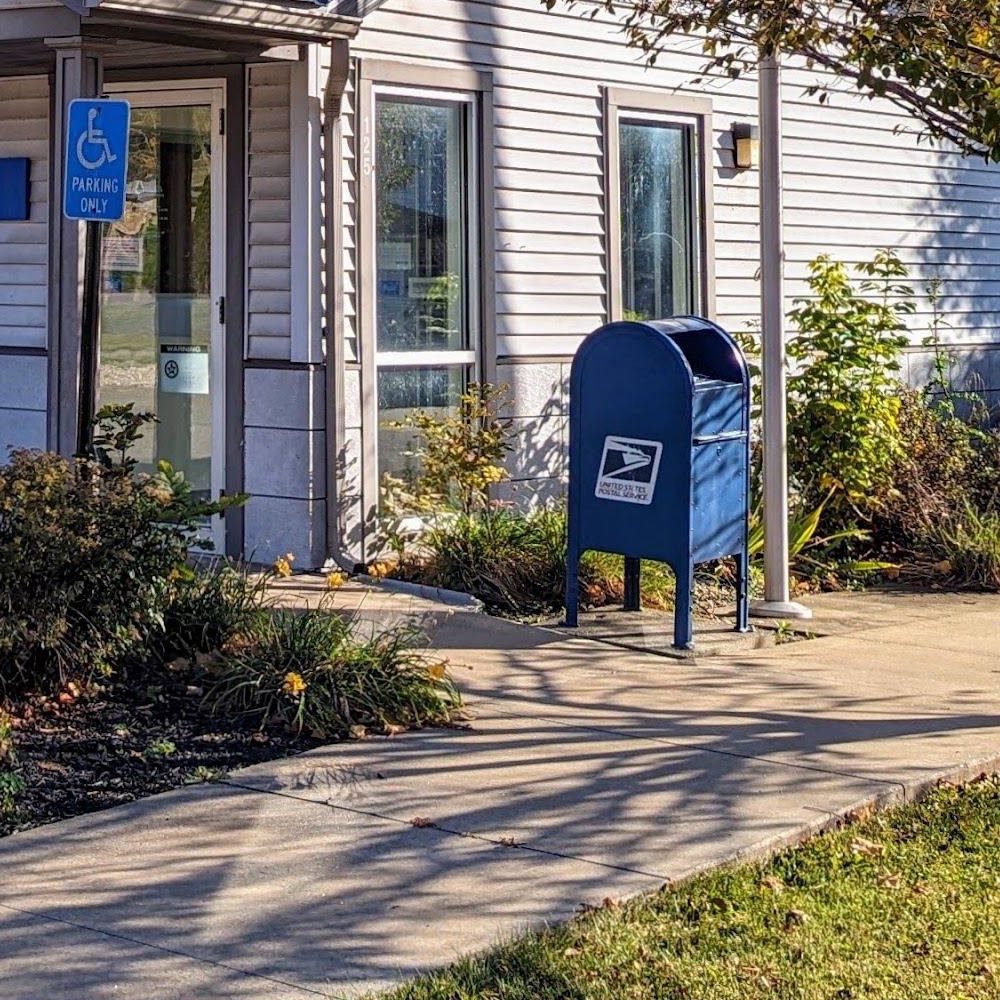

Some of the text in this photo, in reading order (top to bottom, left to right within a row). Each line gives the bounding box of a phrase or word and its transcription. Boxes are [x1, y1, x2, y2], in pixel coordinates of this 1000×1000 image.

[363, 116, 371, 176] 125
[71, 176, 119, 194] PARKING
[80, 197, 109, 214] ONLY
[598, 487, 622, 498] POSTAL
[599, 481, 624, 491] UNITED
